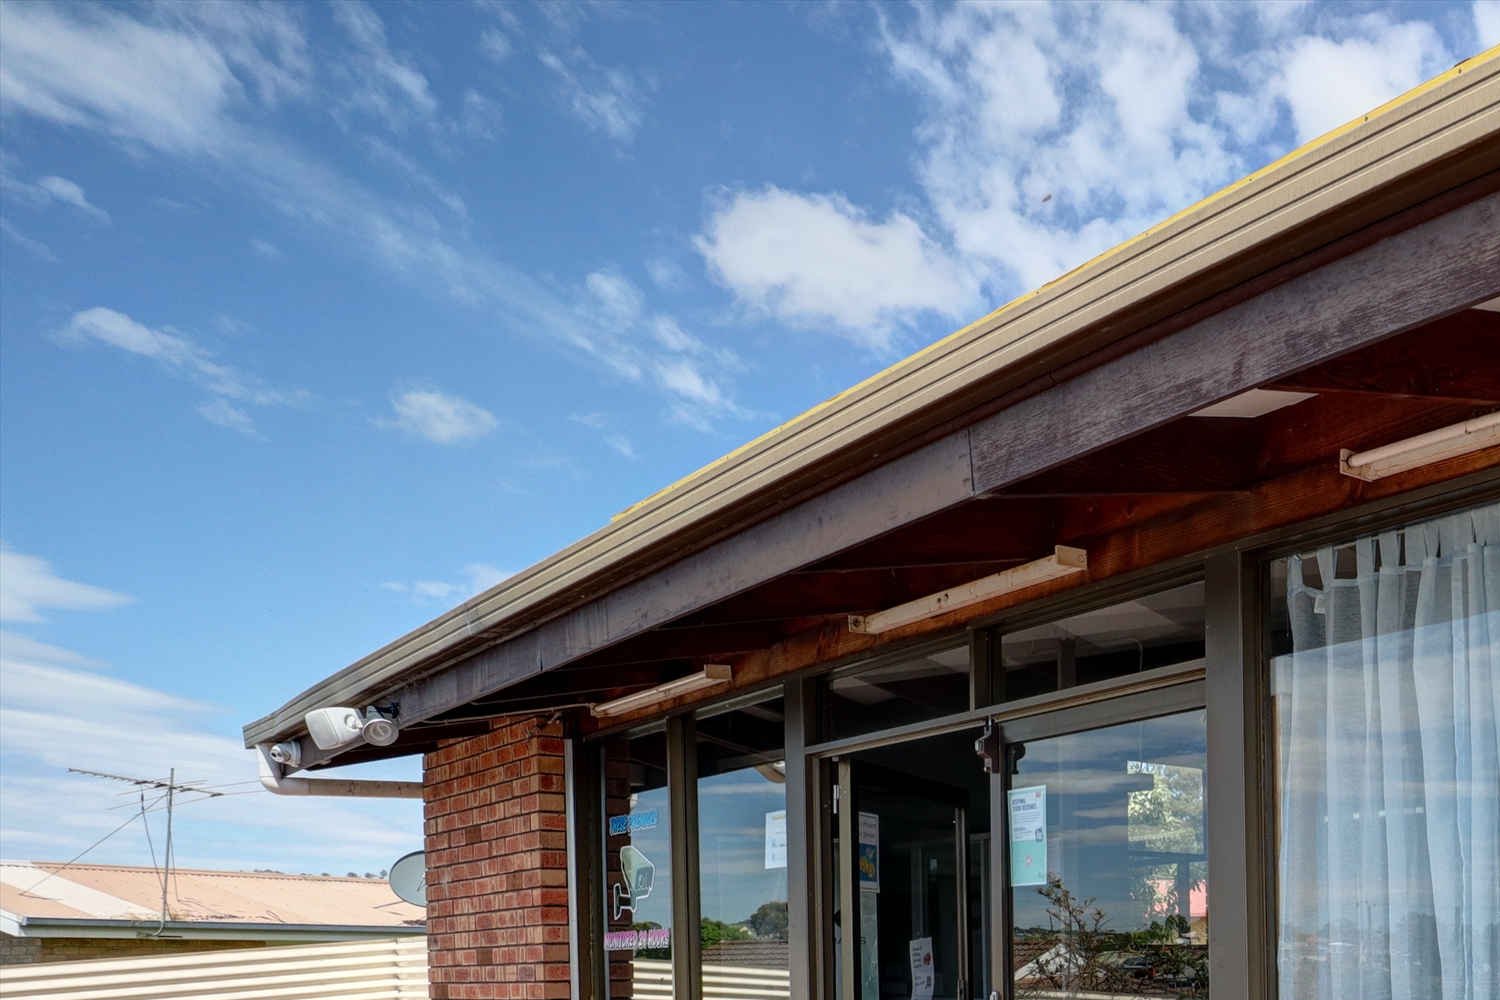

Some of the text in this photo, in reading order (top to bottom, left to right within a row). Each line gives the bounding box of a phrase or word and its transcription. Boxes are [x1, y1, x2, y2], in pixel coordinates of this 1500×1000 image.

[609, 808, 658, 836] THESE PREMISES
[604, 930, 638, 951] MONITORED
[647, 928, 670, 950] HOURS
